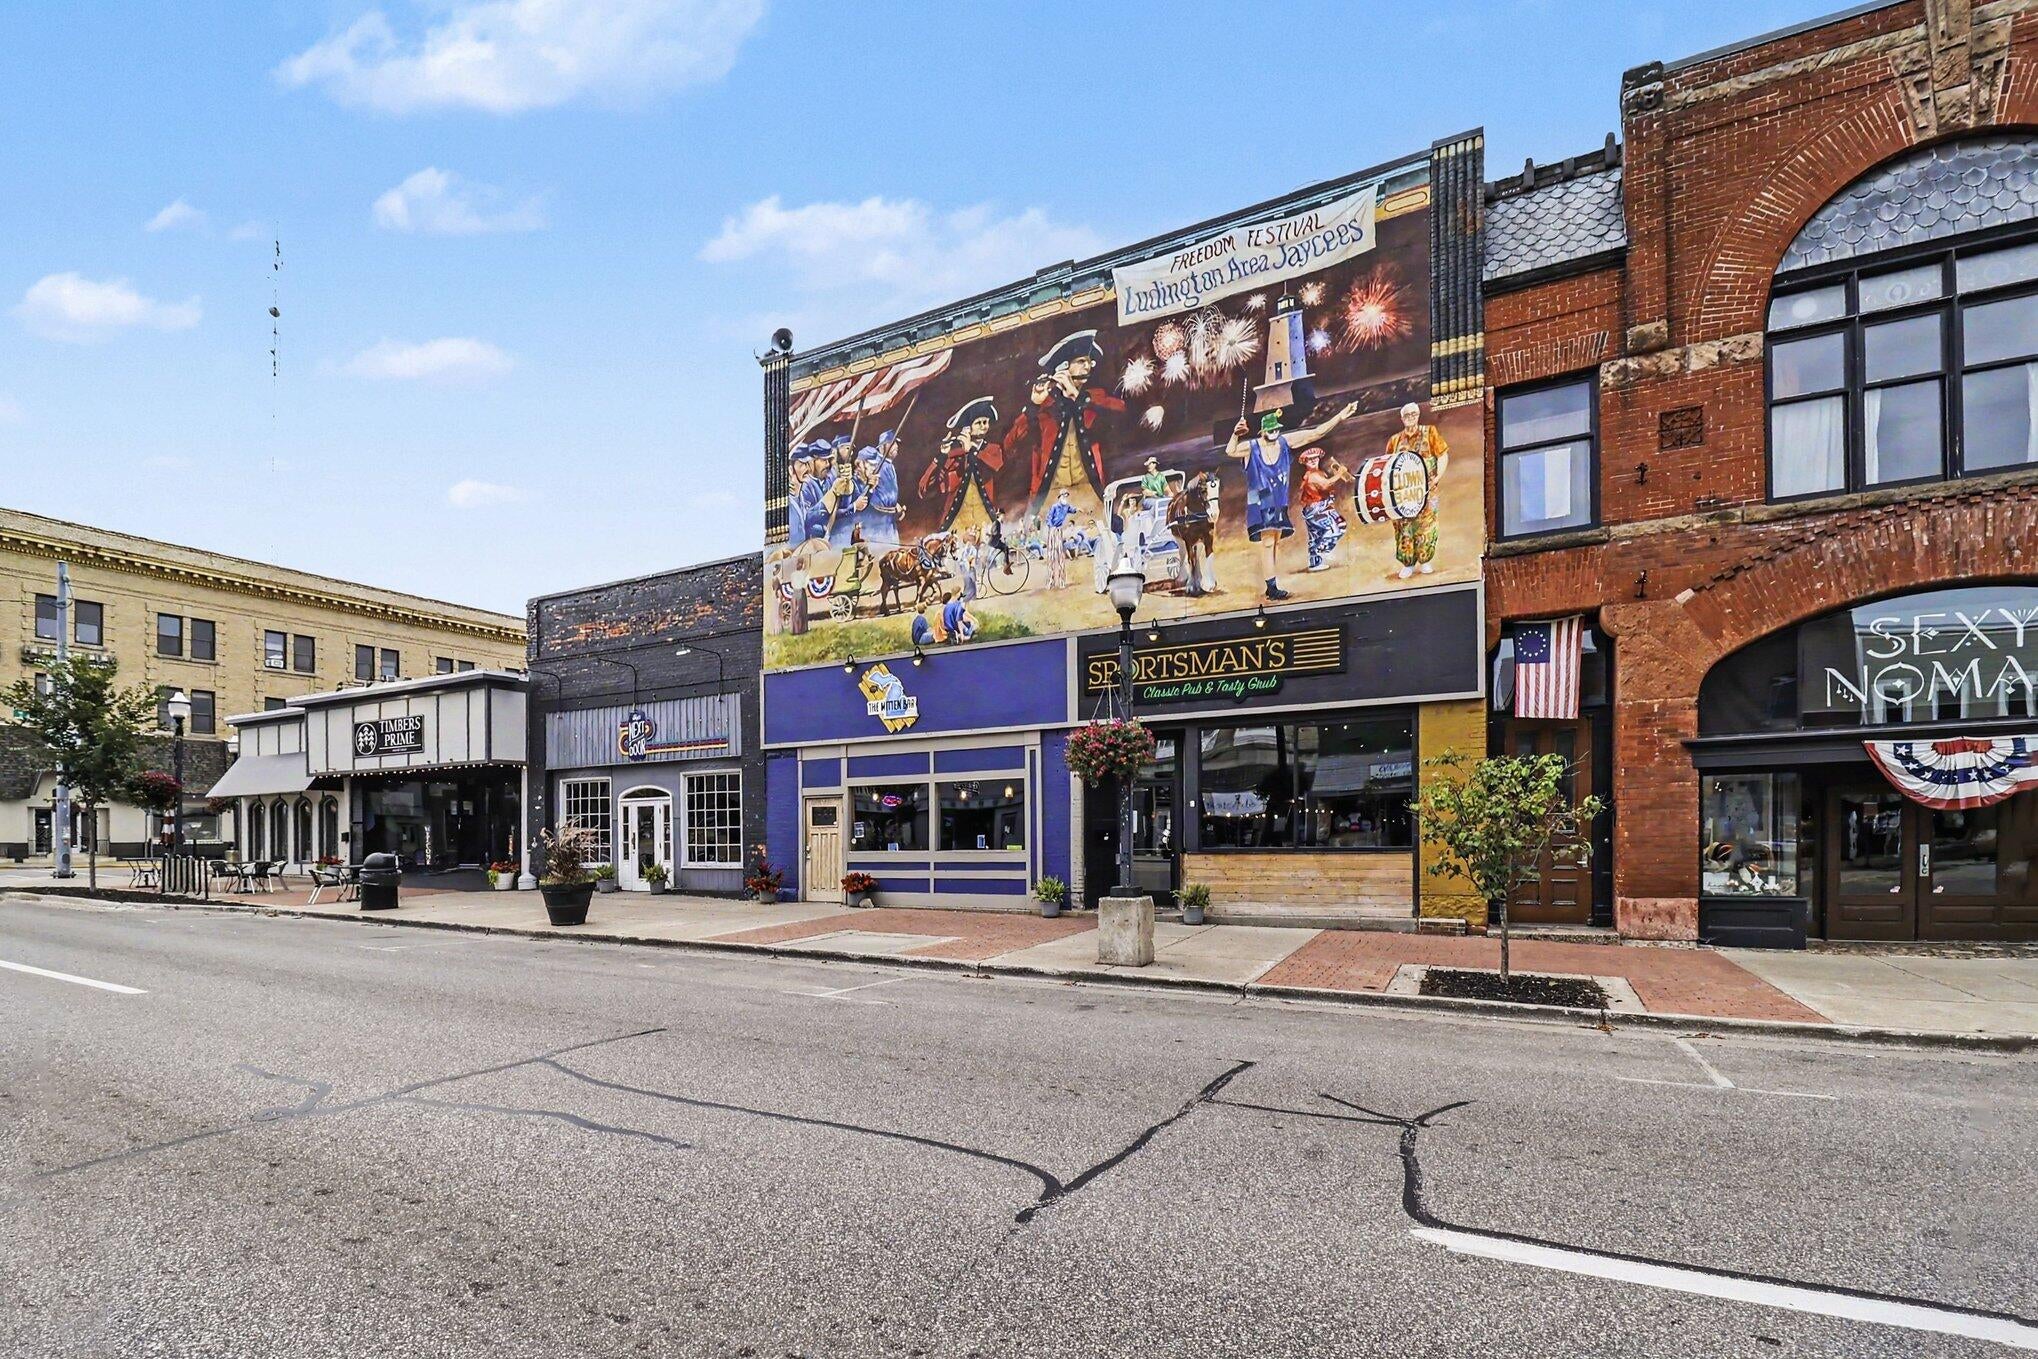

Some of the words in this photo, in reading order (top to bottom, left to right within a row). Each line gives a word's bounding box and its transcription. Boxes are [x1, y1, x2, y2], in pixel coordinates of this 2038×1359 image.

[1170, 235, 1237, 274] FREEDOM
[1247, 213, 1325, 248] FESTIVAL
[1124, 266, 1225, 316] Ludington
[1227, 254, 1269, 284] Area
[1272, 218, 1364, 270] Jaycees
[1866, 606, 2038, 659] SEXY
[1143, 683, 1180, 699] Classic
[1181, 682, 1202, 696] Pub
[1204, 681, 1214, 694] &
[1217, 679, 1246, 698] Tasty
[1247, 674, 1277, 690] Grub
[1824, 655, 2033, 708] NOMA
[868, 702, 879, 713] THE
[379, 716, 421, 734] TIMBERS
[628, 720, 646, 742] NEXT
[384, 731, 415, 747] PRIME
[628, 738, 646, 757] DOOR
